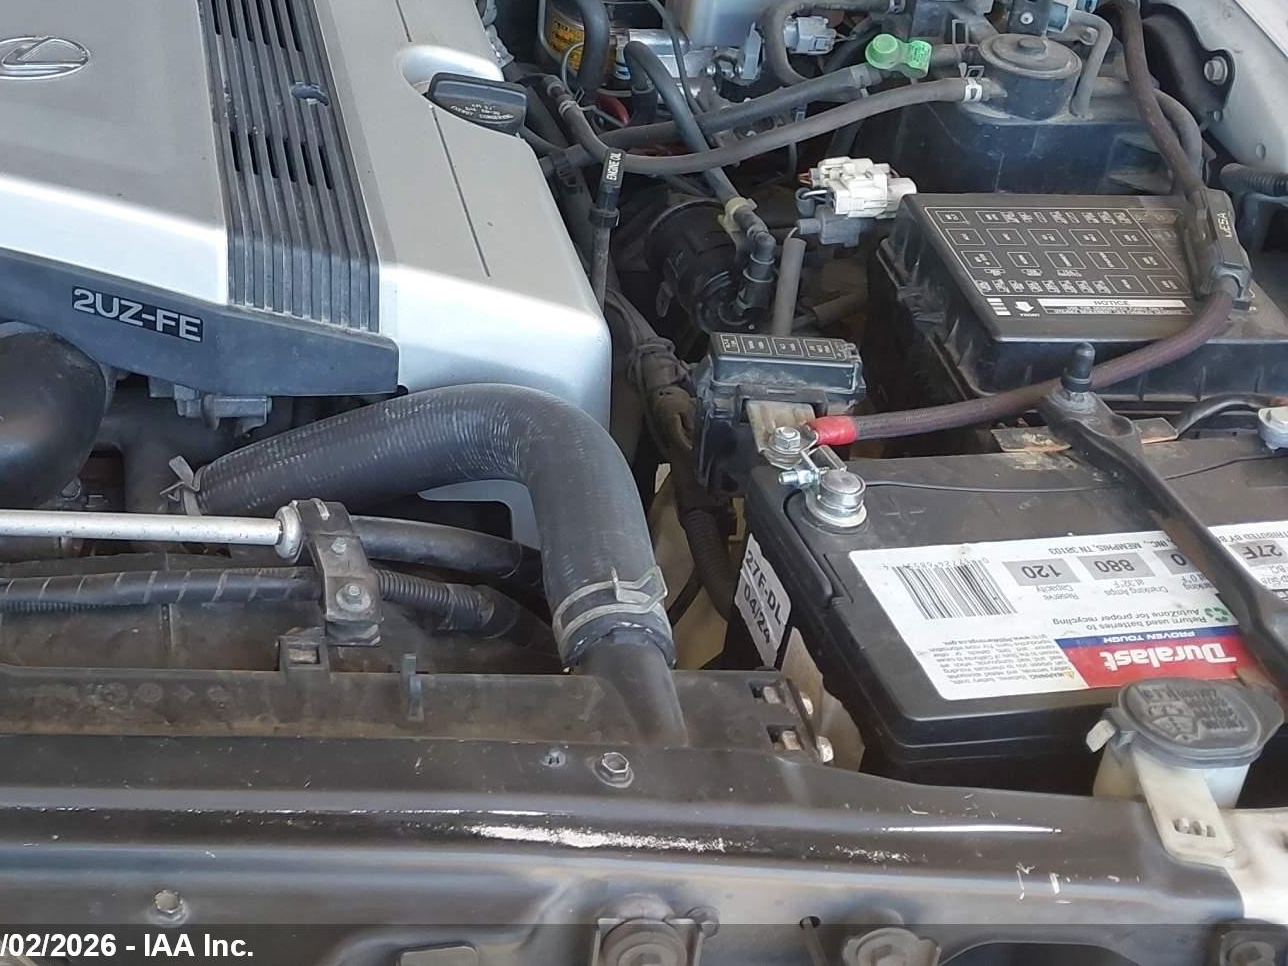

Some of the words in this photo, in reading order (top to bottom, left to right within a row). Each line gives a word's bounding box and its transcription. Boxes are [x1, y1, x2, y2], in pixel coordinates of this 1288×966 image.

[73, 288, 202, 342] 2UZ-FE
[1079, 546, 1094, 554] TN
[1242, 544, 1283, 560] 27F
[1020, 563, 1062, 578] 120
[1094, 559, 1135, 573] 880
[745, 549, 781, 626] 27F-DL
[1036, 584, 1074, 594] Capacity
[1043, 593, 1080, 601] Reserve
[743, 583, 770, 644] 04/24
[1101, 613, 1137, 623] proper
[1138, 611, 1150, 619] for
[1152, 609, 1200, 618] AutoZone
[1052, 615, 1099, 626] recycling
[1099, 620, 1145, 630] batteries
[1146, 618, 1170, 627] used
[1175, 616, 1207, 625] Return
[1086, 623, 1097, 631] to
[1103, 634, 1145, 643] TOUGH
[1146, 631, 1196, 640] PROVEN
[1100, 643, 1238, 671] Duralast
